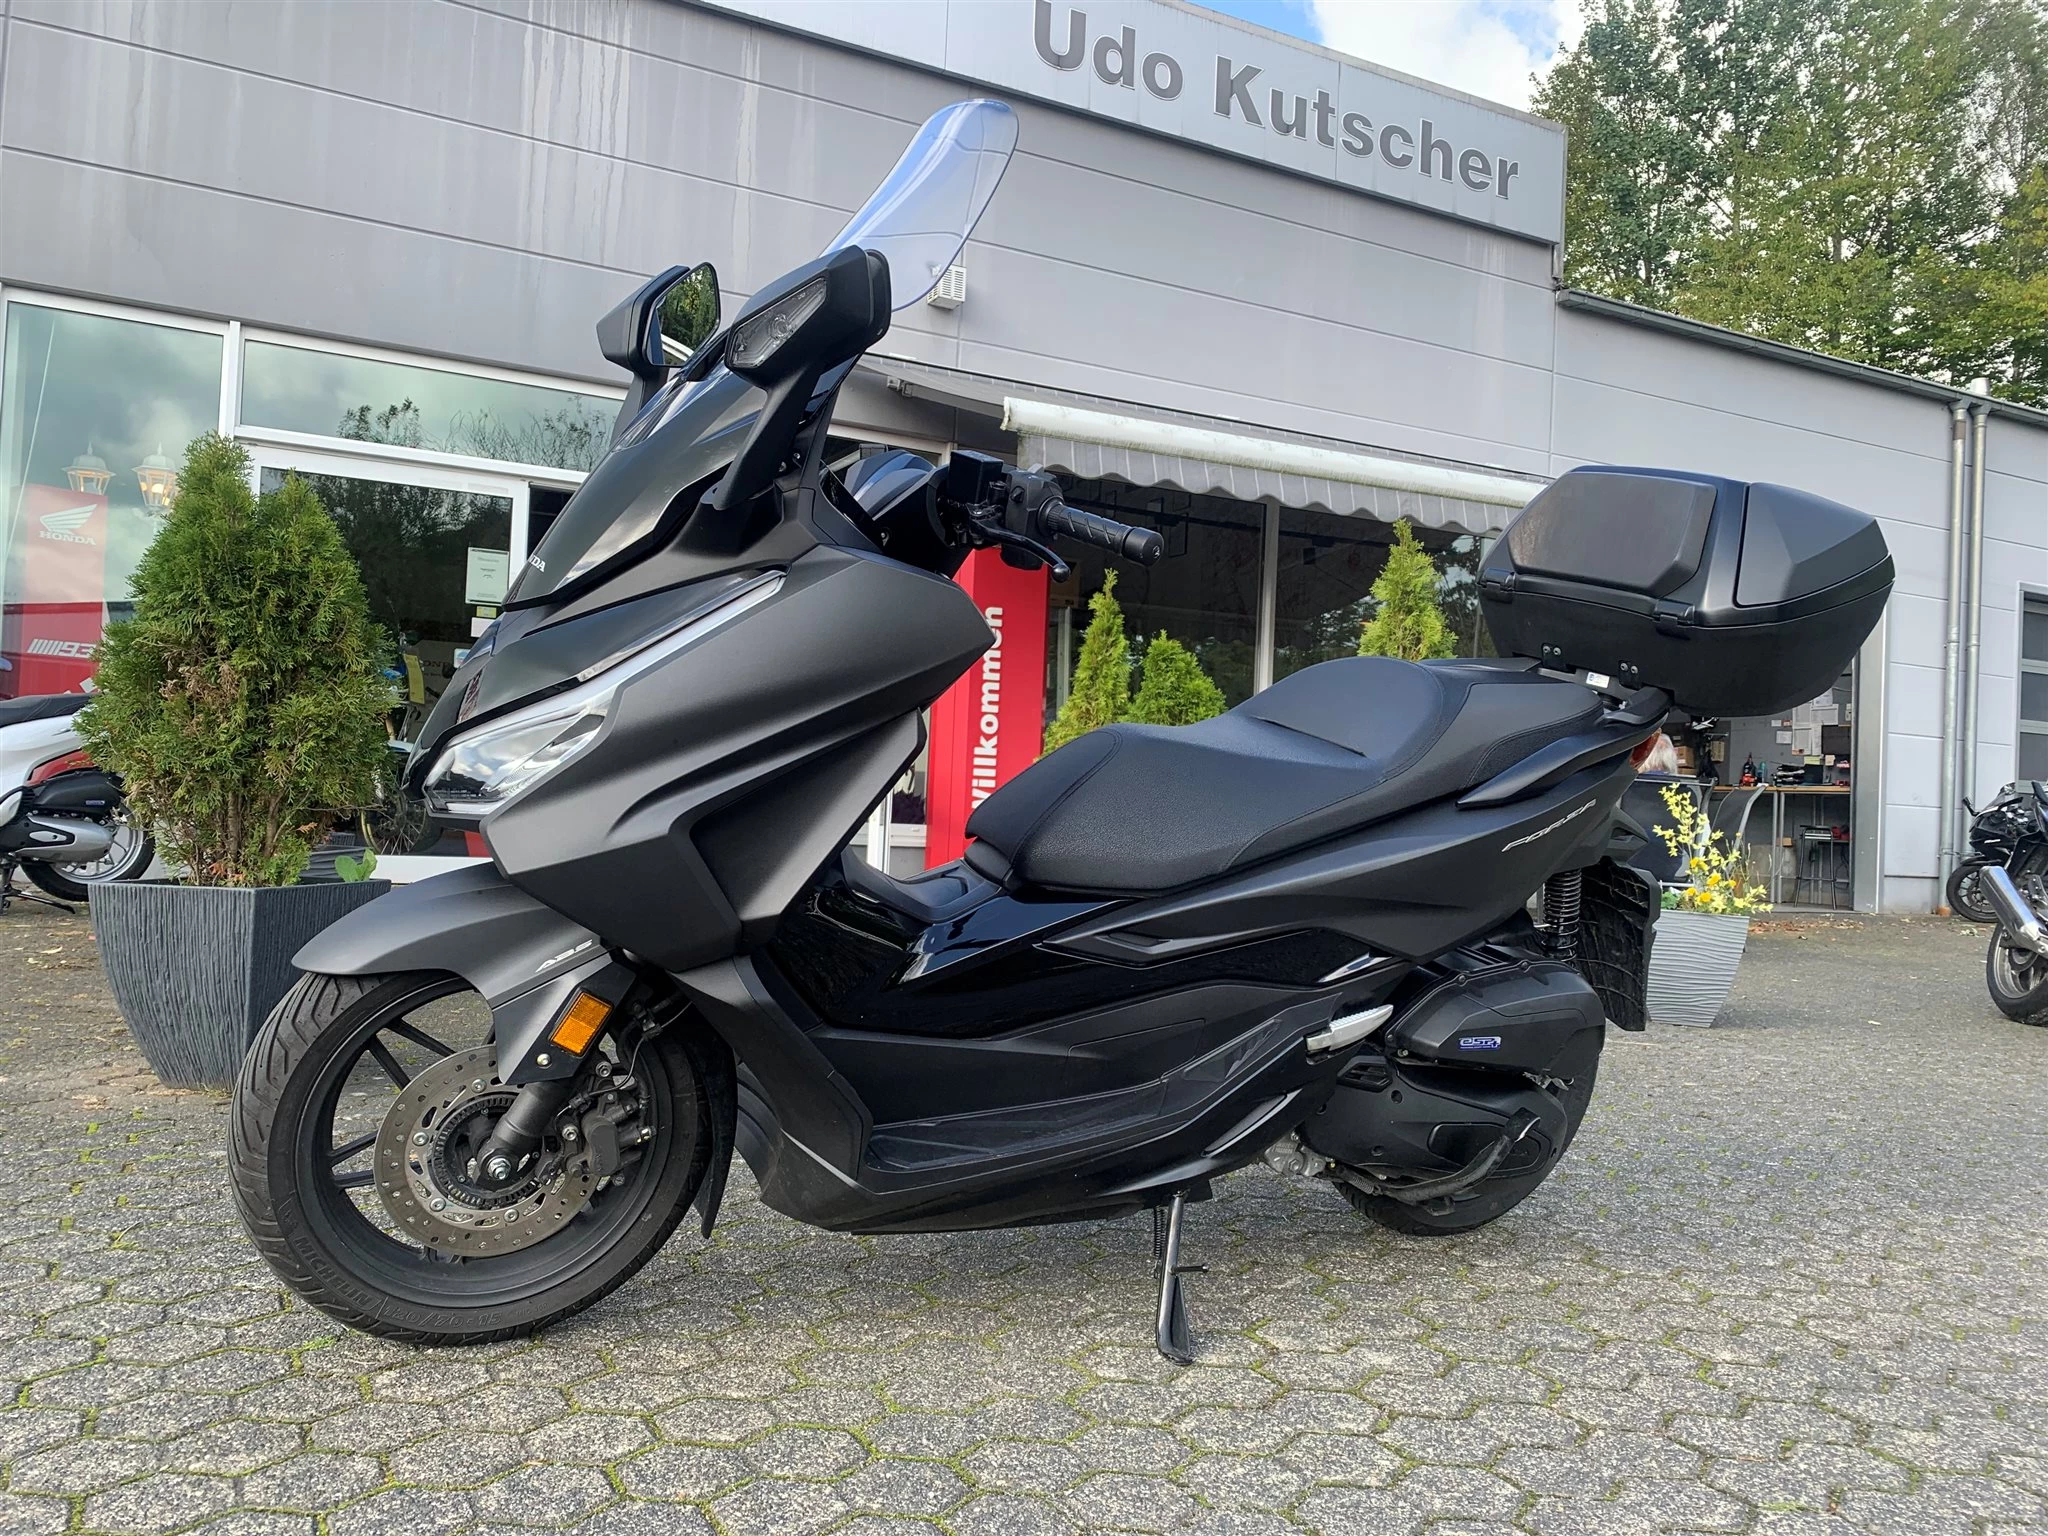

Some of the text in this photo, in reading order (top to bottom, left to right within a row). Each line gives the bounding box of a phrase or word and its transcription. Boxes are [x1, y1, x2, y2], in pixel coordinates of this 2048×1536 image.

[1032, 0, 1520, 200] Udo Kutscher
[39, 530, 97, 546] HONDA
[1501, 798, 1597, 852] FORZA
[535, 939, 593, 973] ABS
[294, 1236, 371, 1308] MICHELIN
